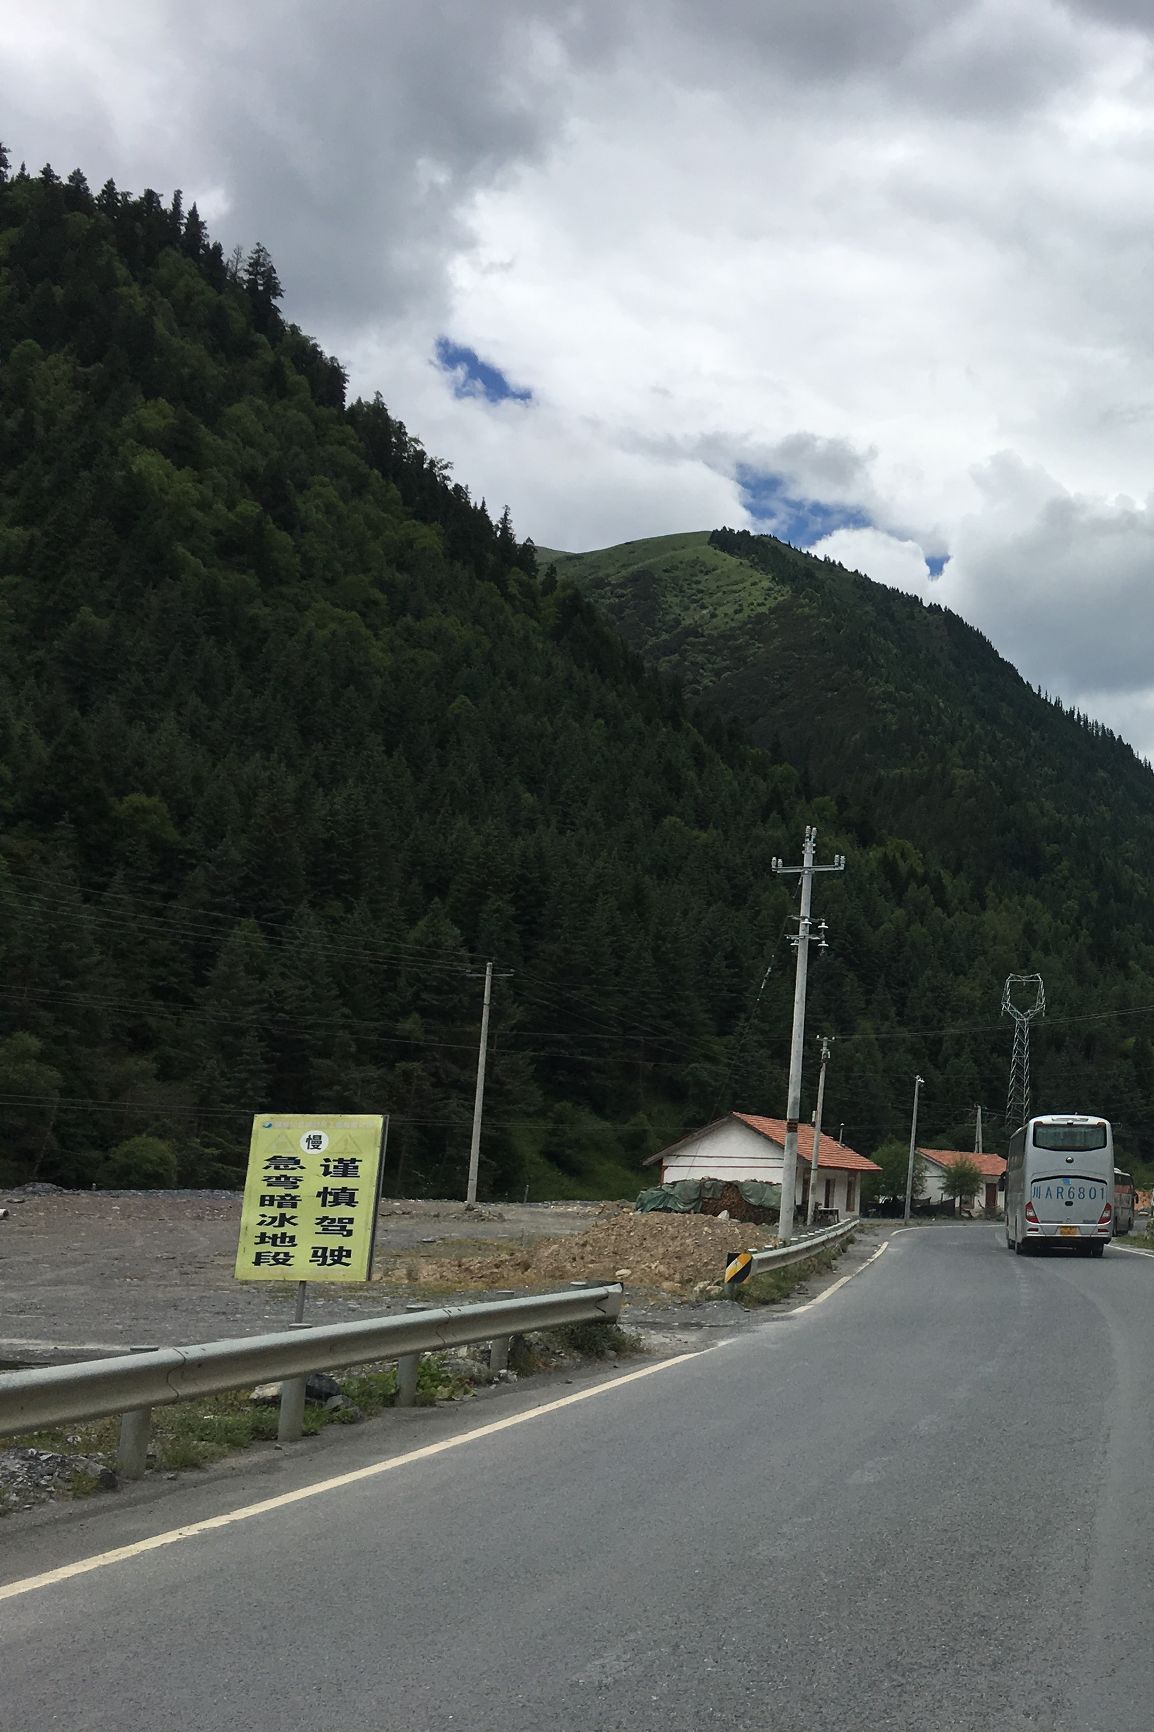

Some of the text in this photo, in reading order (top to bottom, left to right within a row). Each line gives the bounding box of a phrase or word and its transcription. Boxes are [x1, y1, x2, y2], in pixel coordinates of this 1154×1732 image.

[305, 1134, 323, 1151] 慢
[252, 1155, 307, 1267] 急弯暗冰地段
[309, 1157, 363, 1267] 谨慎驾驶
